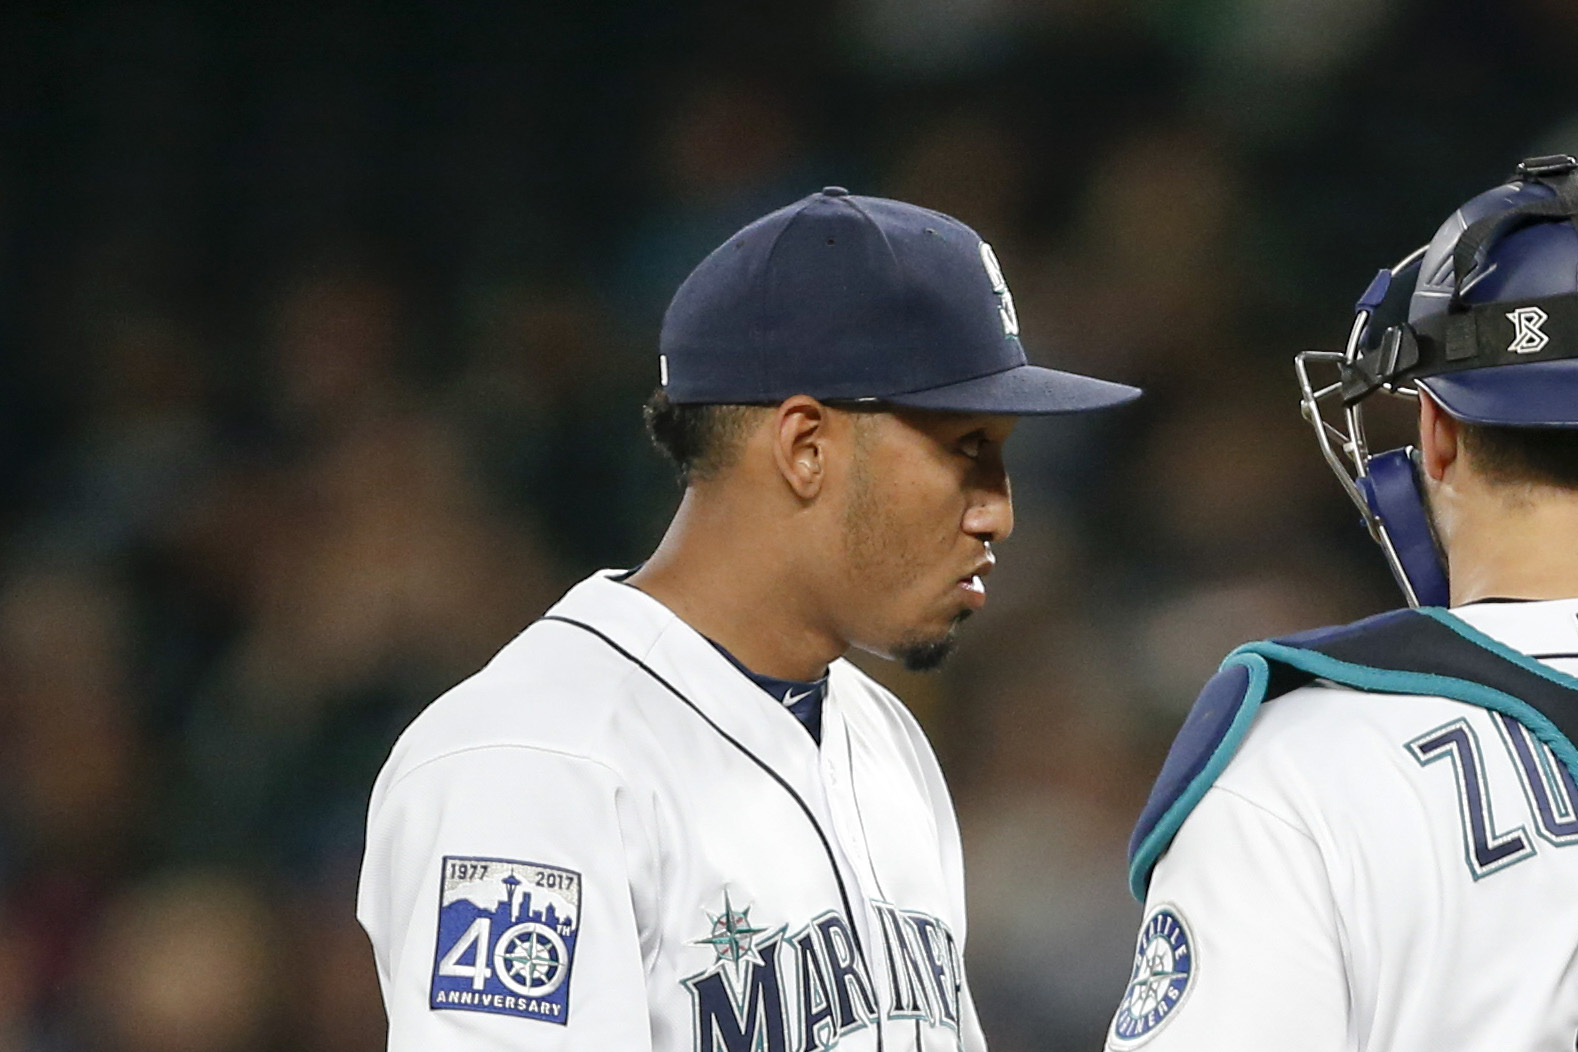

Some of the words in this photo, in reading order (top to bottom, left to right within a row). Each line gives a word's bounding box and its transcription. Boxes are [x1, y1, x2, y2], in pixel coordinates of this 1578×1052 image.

[450, 863, 489, 881] 1977
[535, 872, 575, 891] 2017
[436, 990, 562, 1017] ANNIVERSARY
